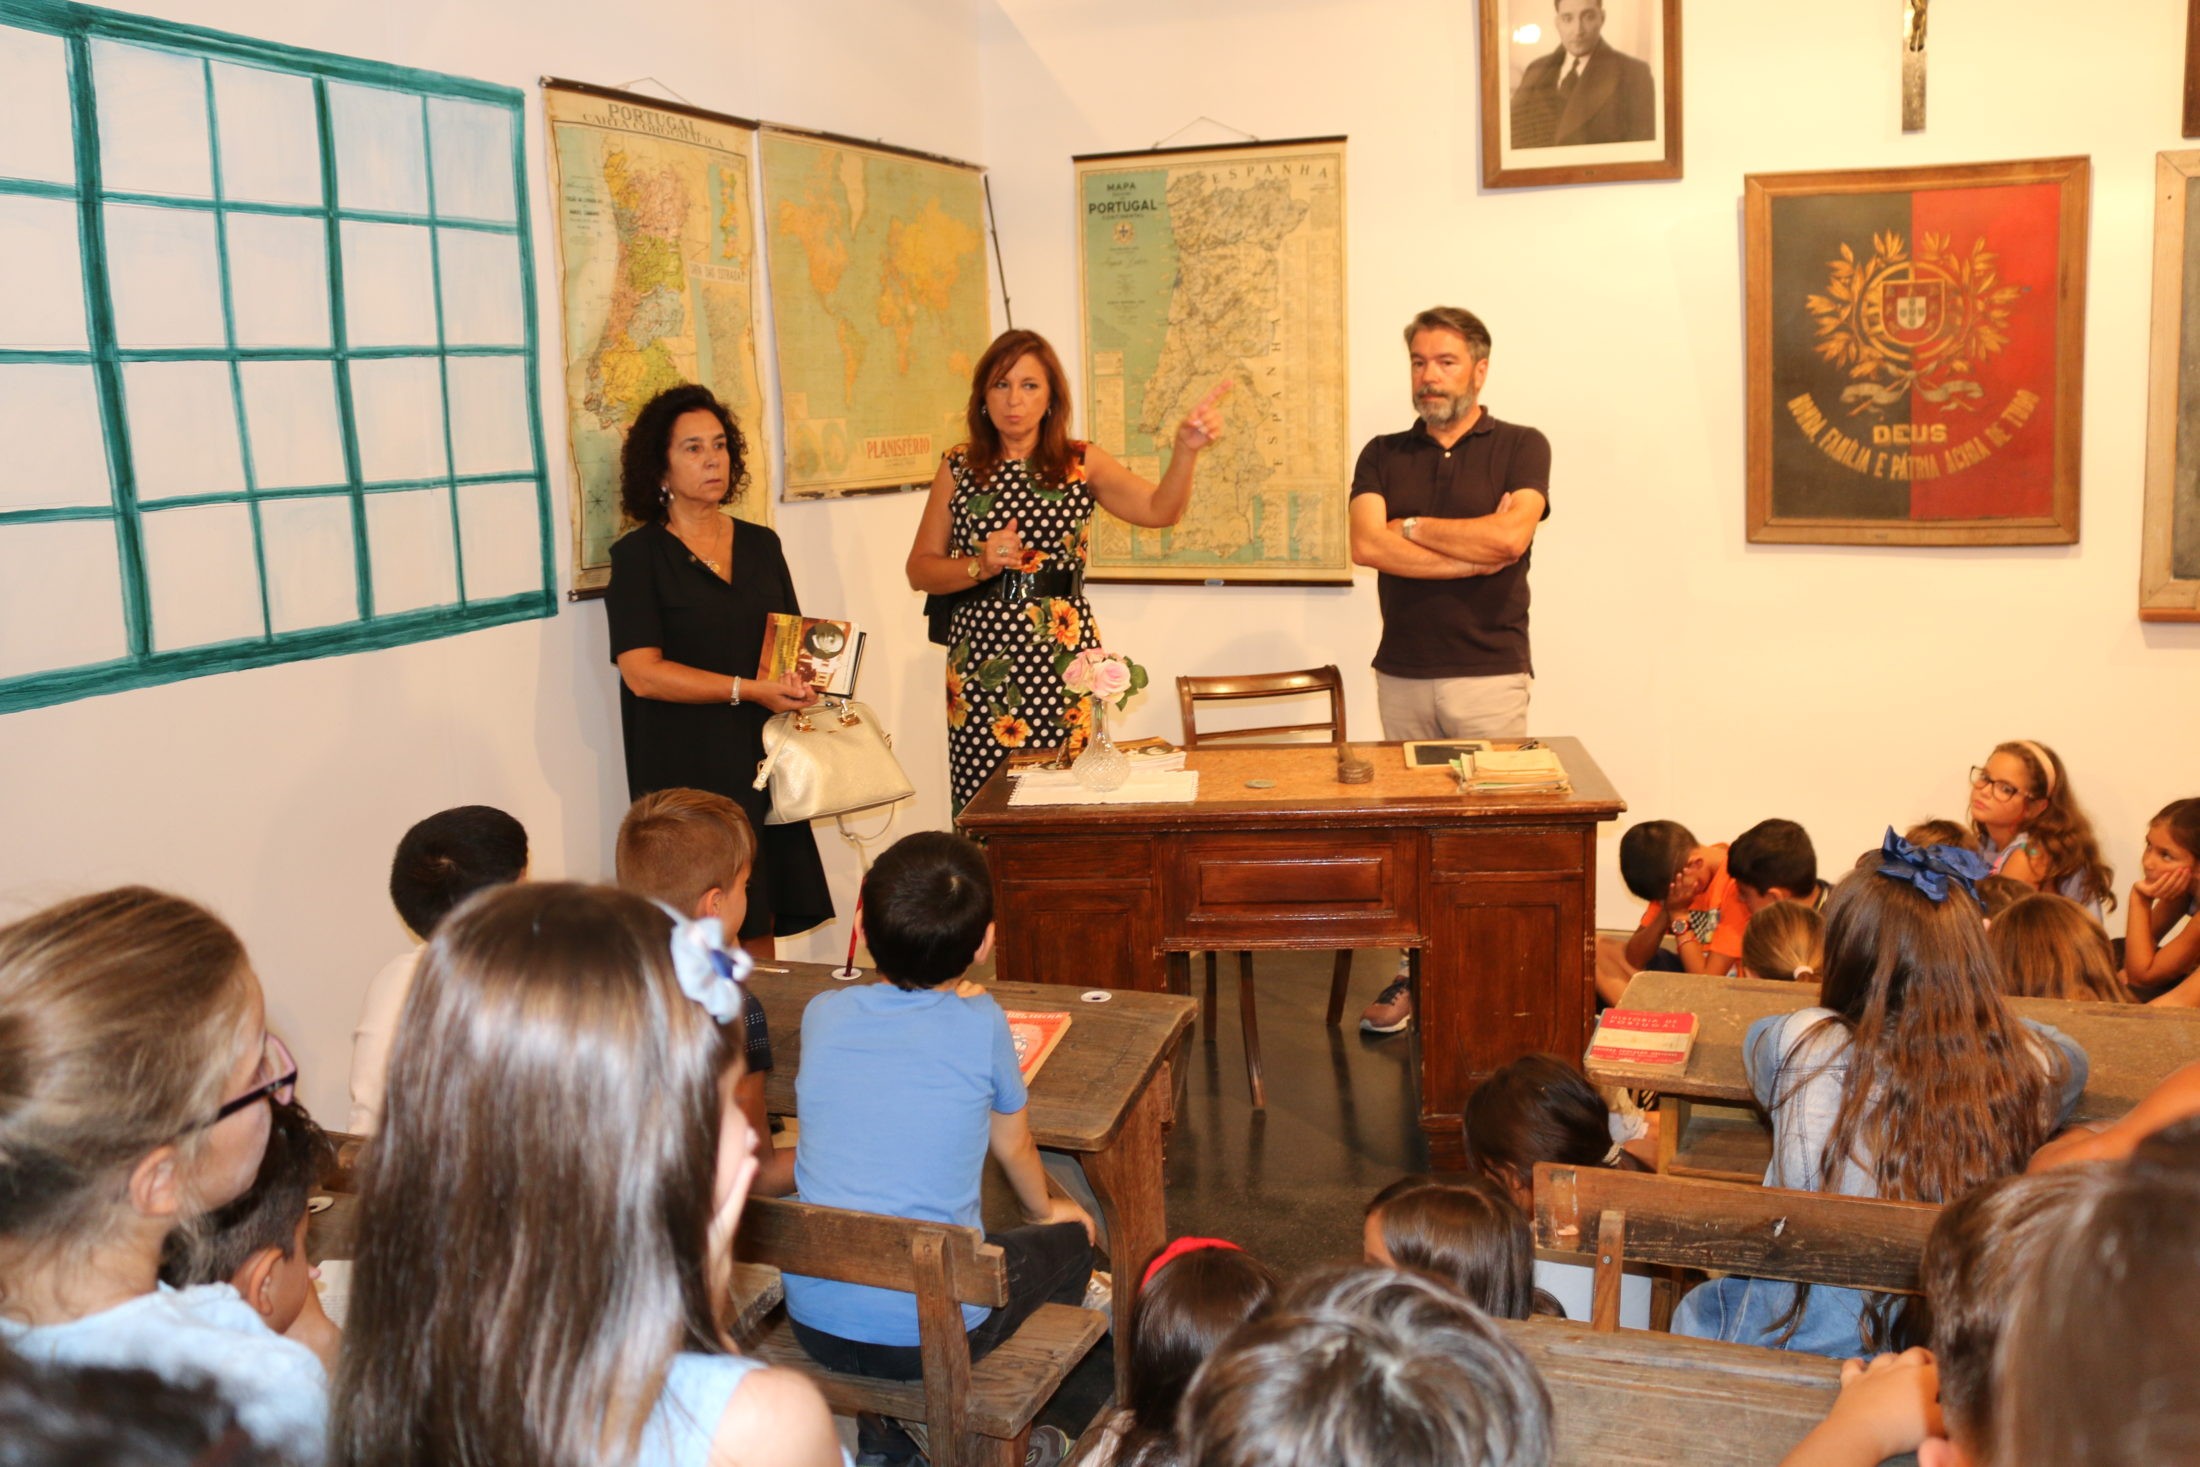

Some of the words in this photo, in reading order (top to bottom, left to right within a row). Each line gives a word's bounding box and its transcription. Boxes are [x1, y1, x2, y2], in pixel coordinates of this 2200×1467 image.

[583, 114, 630, 130] CARTA
[608, 103, 696, 136] PORTUGAL
[1211, 164, 1329, 185] ESPANHA
[1107, 181, 1136, 192] MAPA
[1088, 199, 1157, 215] PORTUGAL
[1872, 424, 1948, 445] DEUS
[1873, 452, 1889, 478] E
